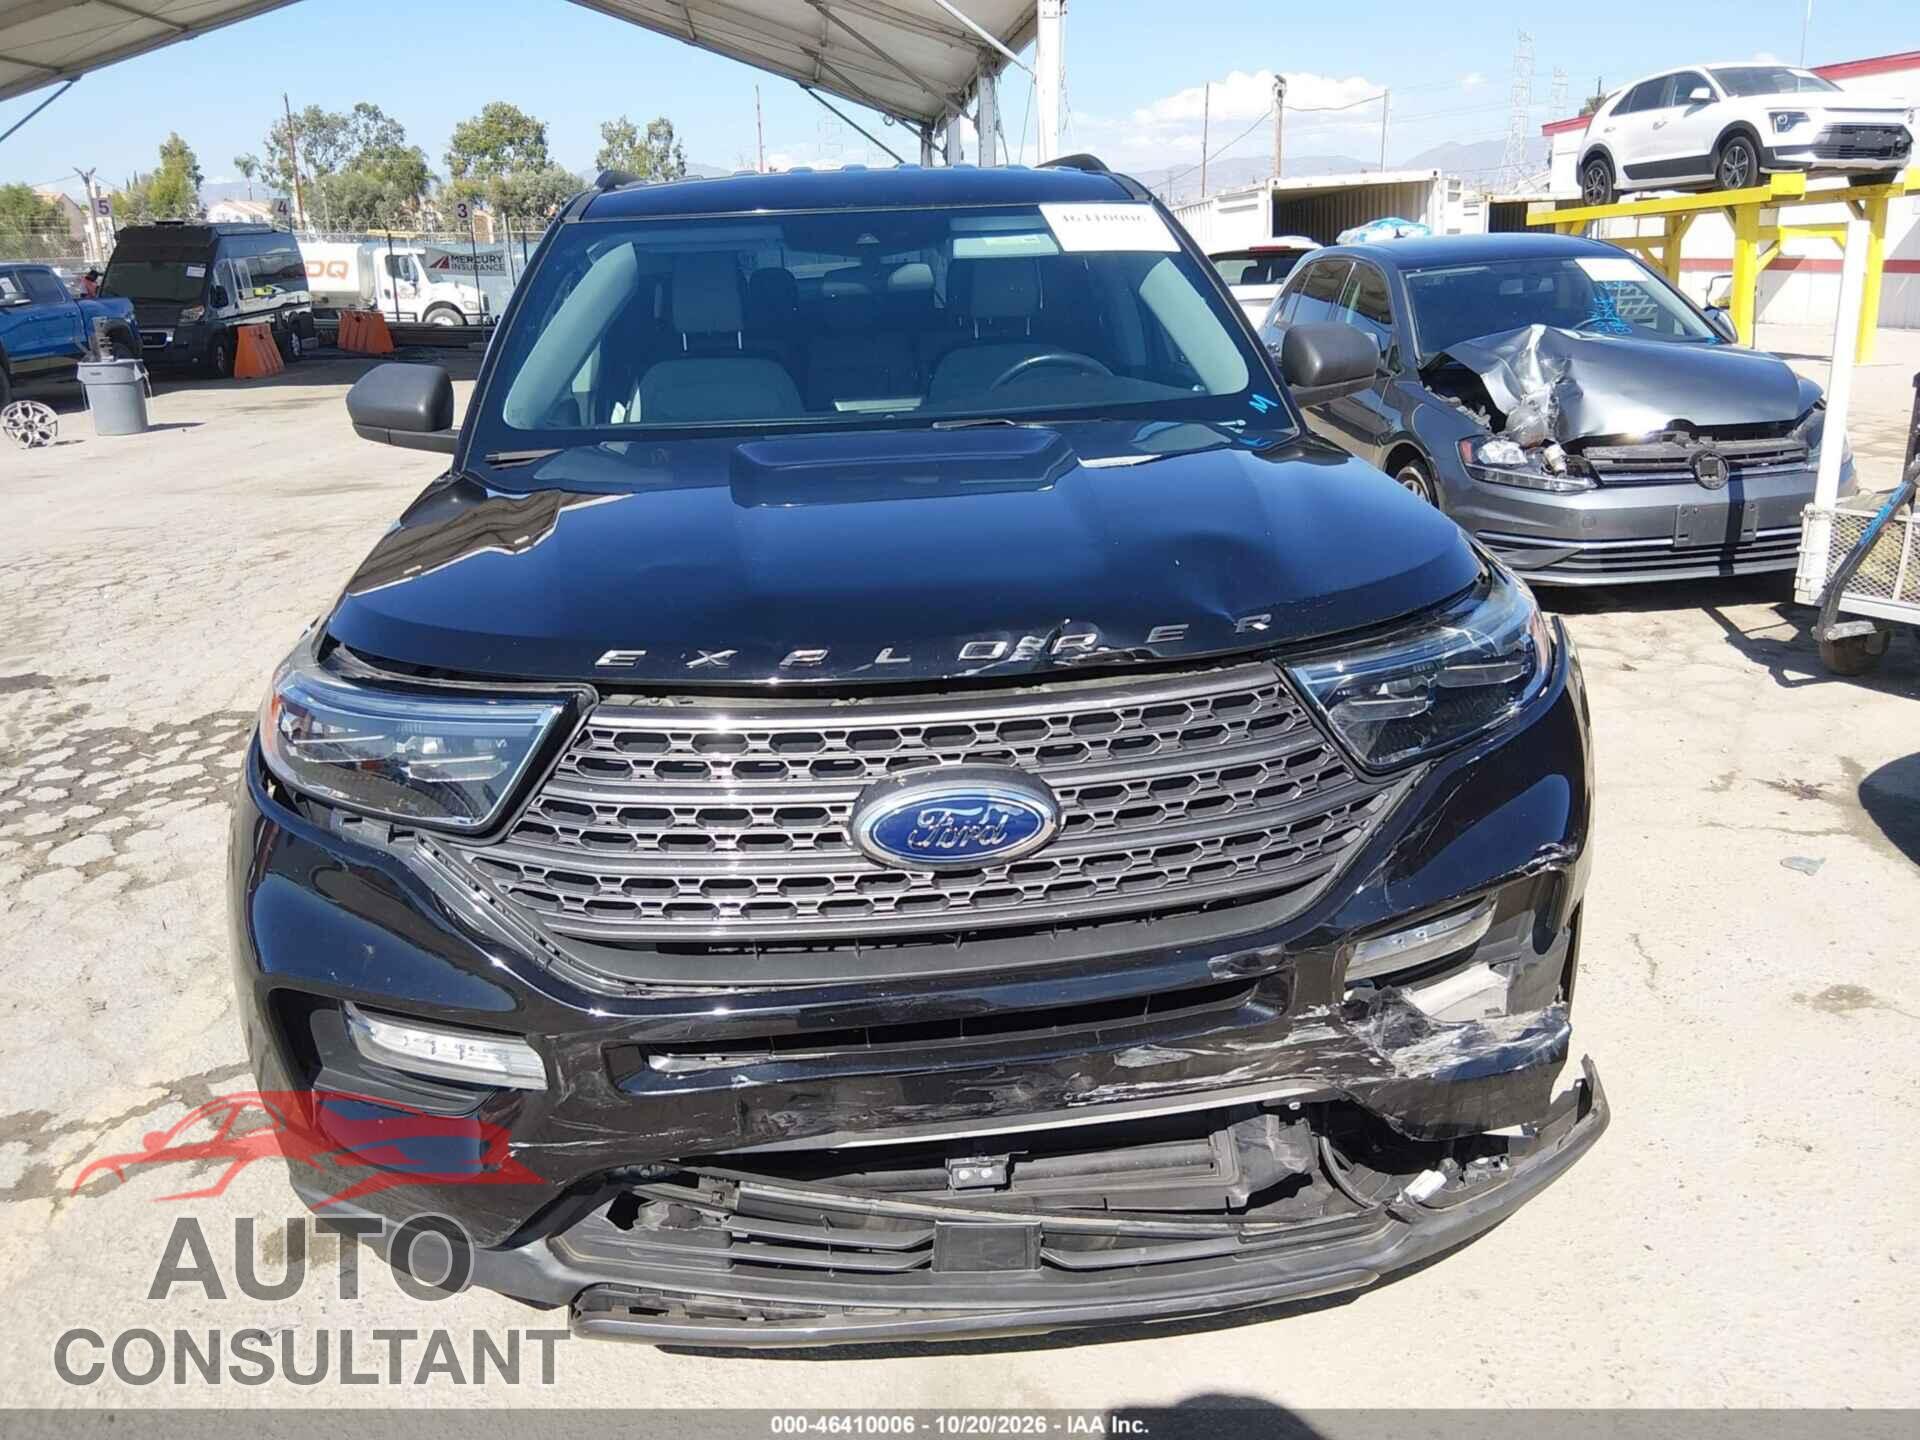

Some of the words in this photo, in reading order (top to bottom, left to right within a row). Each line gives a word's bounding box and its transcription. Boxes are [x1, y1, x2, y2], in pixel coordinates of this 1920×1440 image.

[99, 199, 110, 216] 5
[277, 199, 289, 216] 4
[457, 202, 469, 220] 3
[450, 255, 504, 264] MERCURY
[594, 613, 1272, 670] EXPLORER
[907, 803, 1025, 849] Ford
